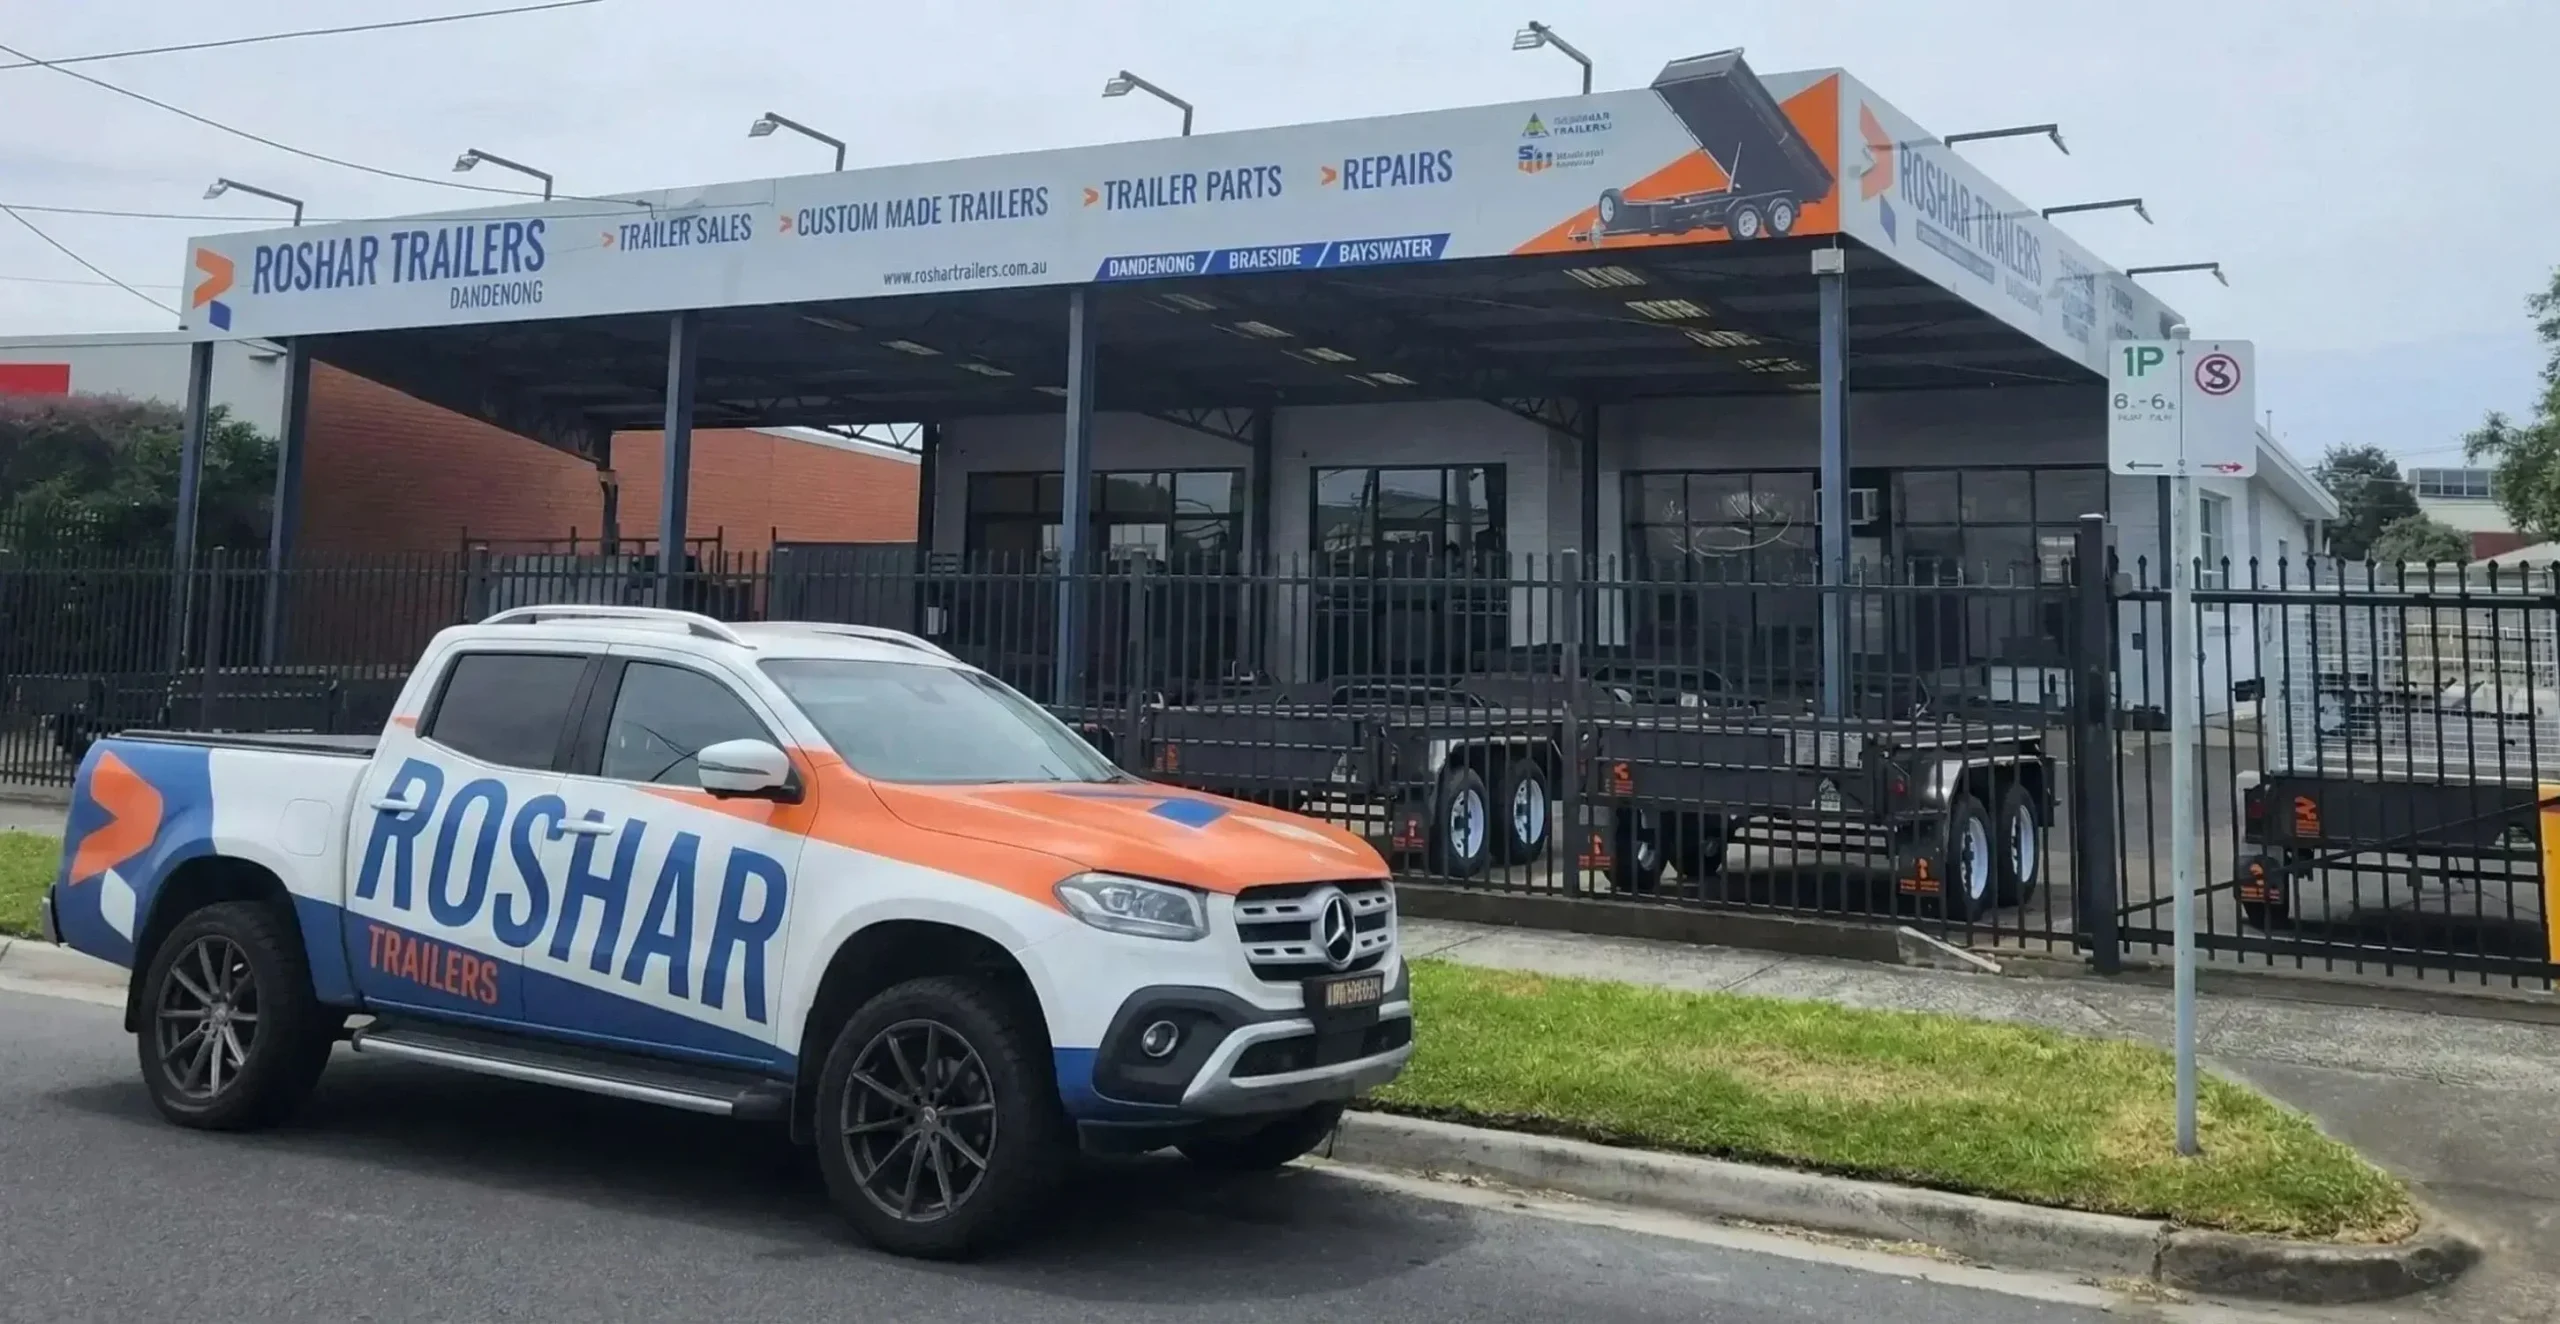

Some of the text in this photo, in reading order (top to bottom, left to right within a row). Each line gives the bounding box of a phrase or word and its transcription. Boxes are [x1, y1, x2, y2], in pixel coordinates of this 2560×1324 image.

[1104, 165, 1282, 211] TRAILER PARTS
[1343, 149, 1453, 191] REPAIRS
[619, 213, 752, 251] TRAILER SALES
[797, 185, 1049, 237] CUSTOM MADE TRAILERS
[1900, 140, 1971, 244] ROSHAR
[1975, 195, 2042, 288] TRAILERS
[252, 218, 546, 294] ROSHAR TRAILERS
[883, 259, 1048, 286] www.roshartrailers.com.au
[1109, 239, 1433, 277] DANDENONG BRAESIDE BAYSWATER
[450, 280, 543, 309] DANDENONG
[2123, 346, 2164, 377] 1P
[355, 757, 788, 1025] ROSHAR
[369, 925, 498, 1005] TRAILERS
